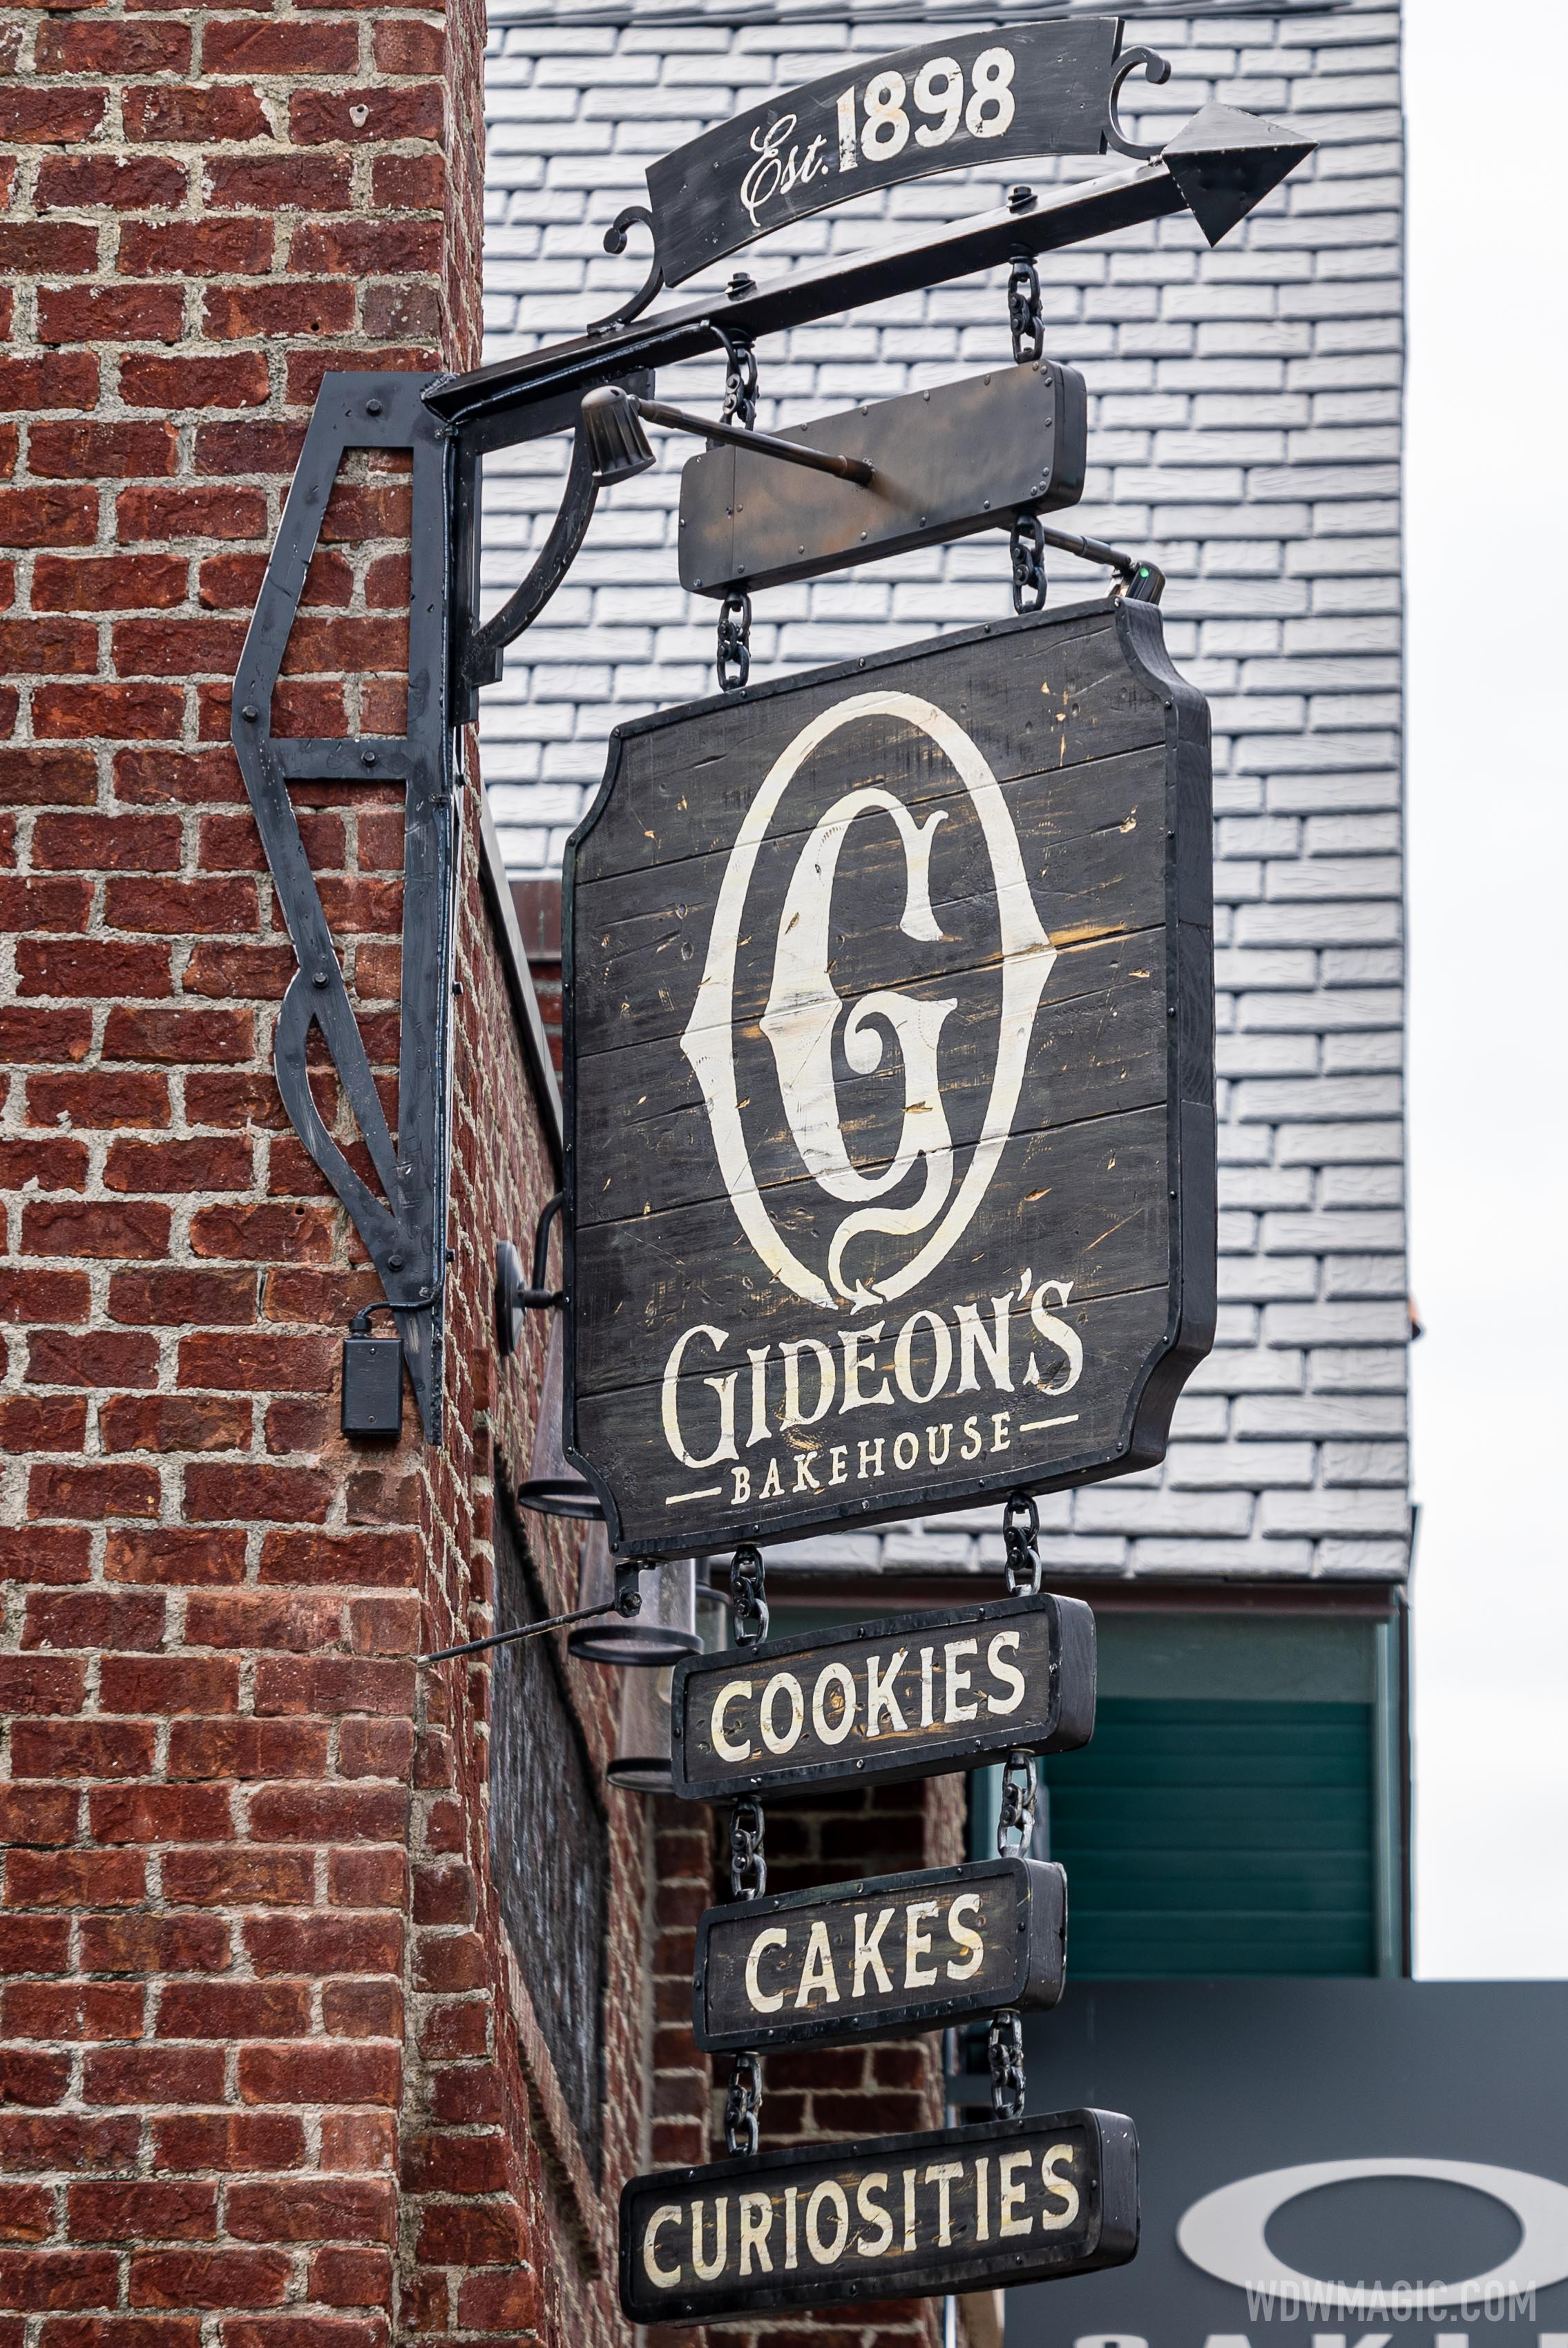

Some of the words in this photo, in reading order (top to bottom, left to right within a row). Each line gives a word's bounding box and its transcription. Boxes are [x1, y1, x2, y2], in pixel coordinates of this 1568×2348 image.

[740, 114, 828, 227] Est.
[836, 47, 1015, 172] 1898
[661, 1268, 1084, 1469] GIDEON'S
[730, 1411, 1011, 1505] BAKEHOUSE
[711, 1631, 1028, 1764] COOKIES
[745, 1893, 984, 2014] CAKES
[643, 2144, 1080, 2288] CURIOSITIES
